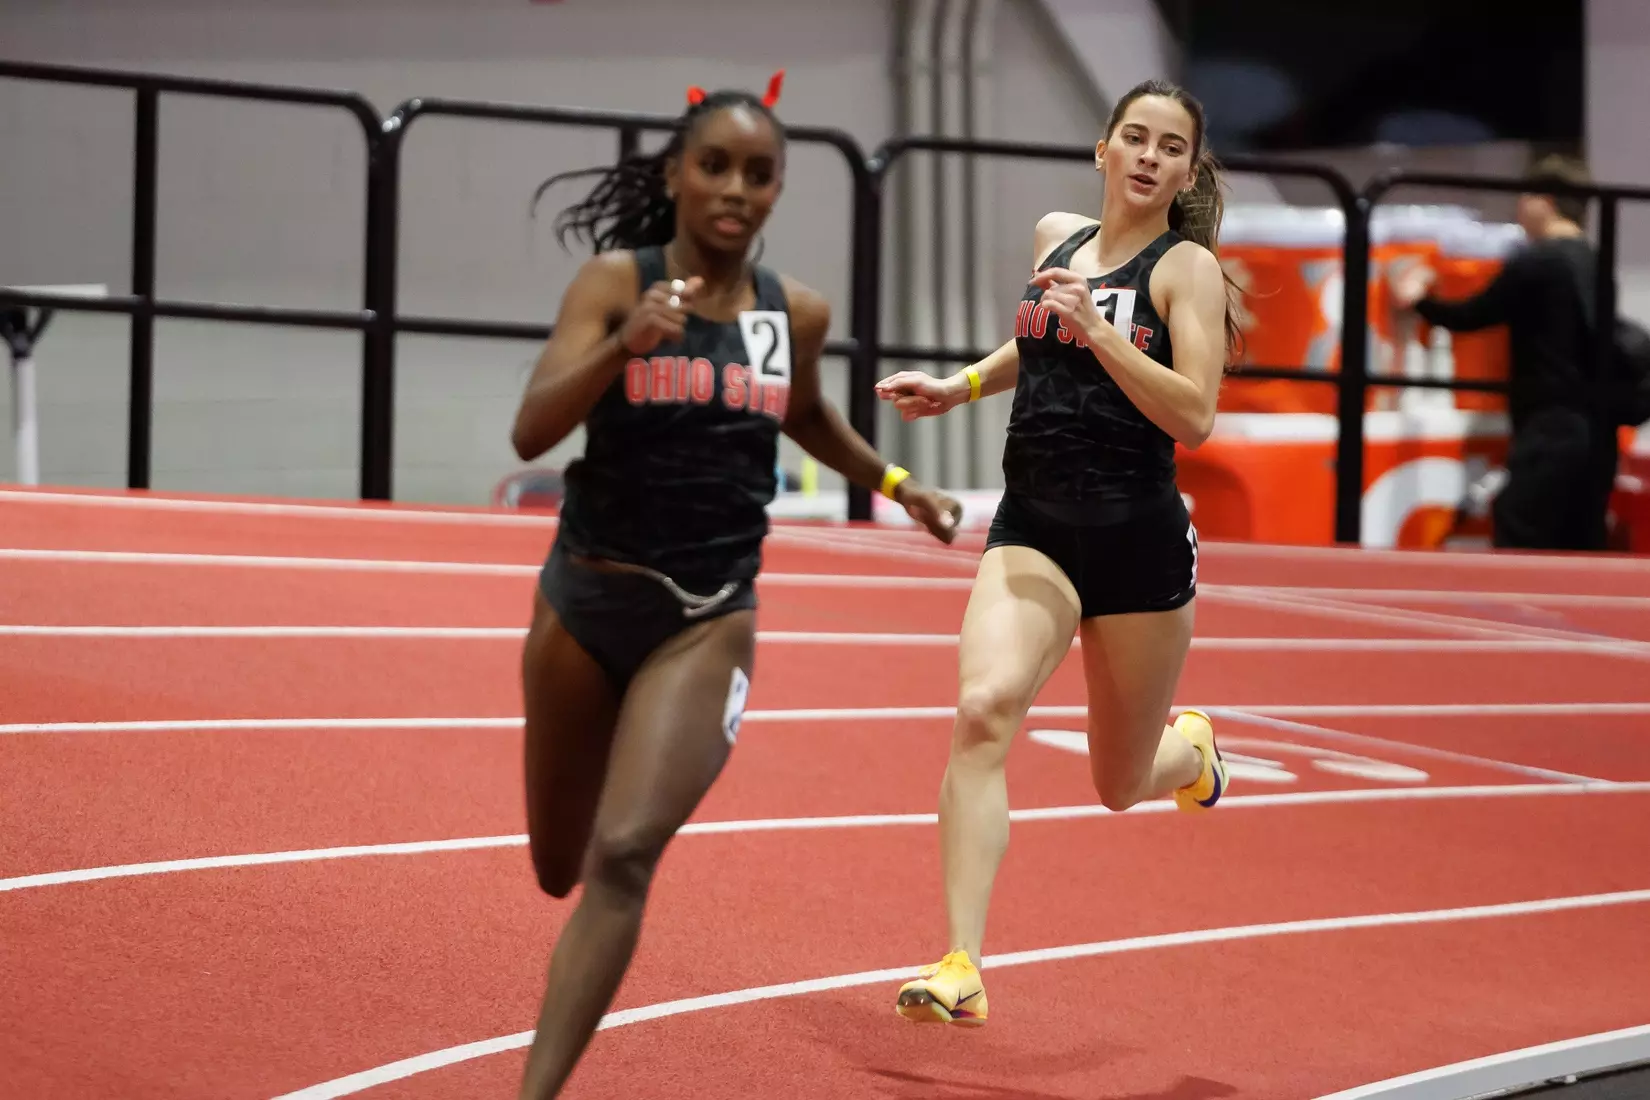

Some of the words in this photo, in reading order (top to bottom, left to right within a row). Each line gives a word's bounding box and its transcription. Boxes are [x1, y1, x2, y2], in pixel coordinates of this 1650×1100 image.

[1096, 293, 1119, 330] 1
[751, 319, 784, 377] 2
[625, 356, 714, 406] OHIO
